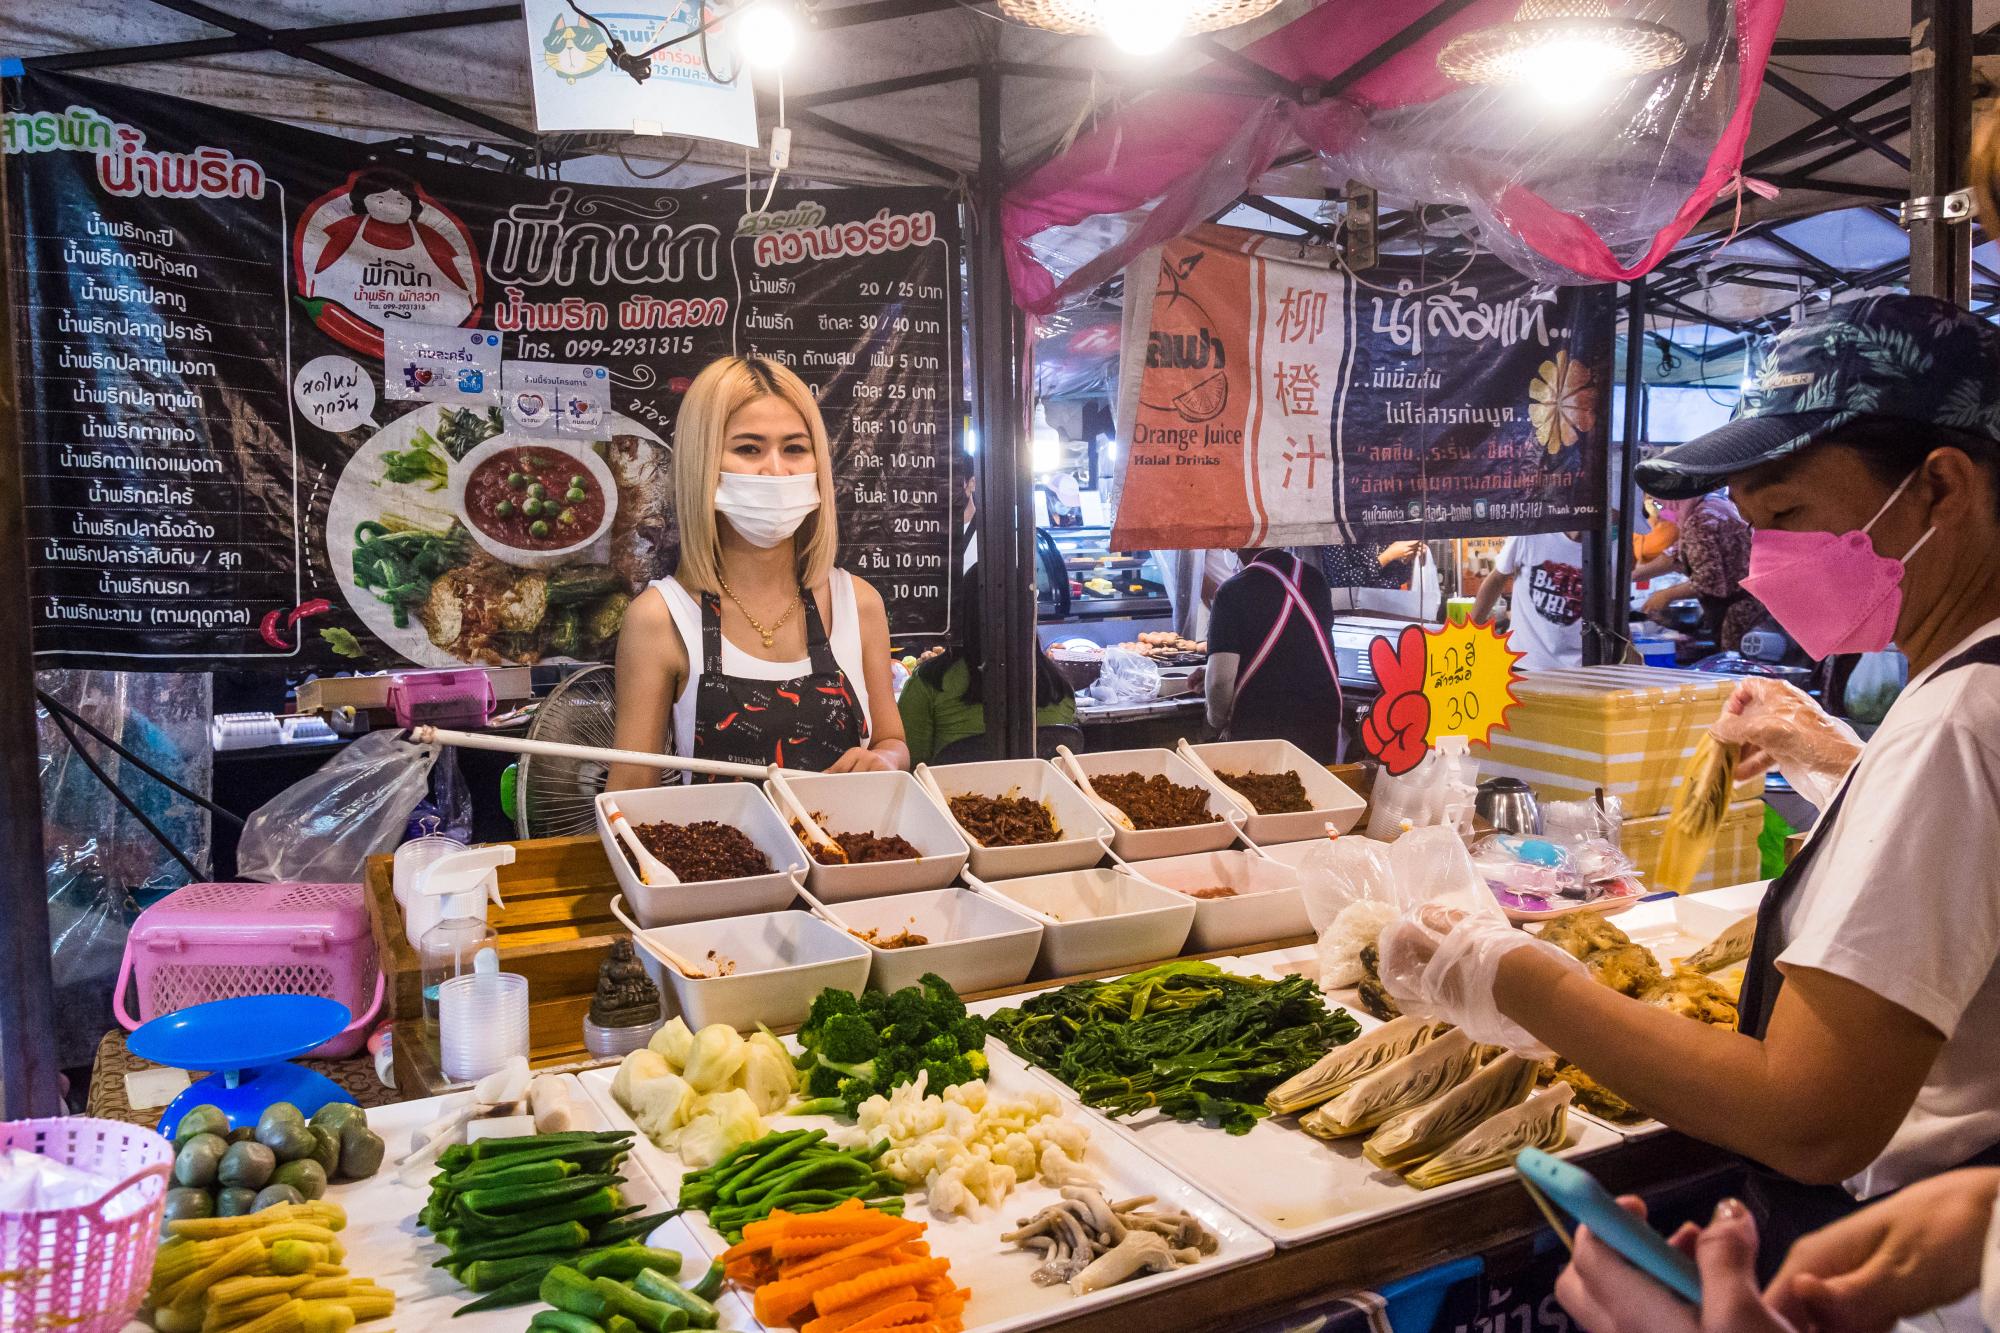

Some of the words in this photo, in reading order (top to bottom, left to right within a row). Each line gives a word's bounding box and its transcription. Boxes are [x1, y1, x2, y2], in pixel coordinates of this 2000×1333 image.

[100, 127, 262, 197] น้ำพริก
[87, 211, 173, 248] น้ำพริกกะปิ
[756, 207, 934, 266] ความอร่อย
[63, 239, 199, 279] น้ำพริกกะปิกุ้งสด
[81, 276, 188, 313] น้ำพริกปลาทู
[353, 285, 395, 303] น้ำพริก
[749, 272, 797, 295] น้ำพริก
[859, 282, 880, 296] 20
[885, 281, 894, 296] /
[898, 282, 914, 299] 25
[918, 284, 944, 300] บาท
[494, 286, 609, 333] น้ำพริก
[618, 294, 729, 332] ผักลวก
[745, 306, 794, 331] น้ำพริก
[817, 314, 854, 331] ขีดละ
[858, 314, 878, 330] 30
[881, 316, 889, 331] /
[892, 316, 910, 333] 40
[915, 319, 941, 335] บาท
[58, 344, 217, 378] น้ำพริกปลาทูแมงดา
[517, 334, 556, 360] โทร.
[564, 336, 695, 359] 099-2931315
[802, 349, 857, 367] ตักผสม
[870, 346, 895, 368] เพิ่ม
[899, 354, 909, 369] 5
[913, 356, 939, 370] บาท
[302, 365, 359, 397] สดใหม่
[852, 381, 883, 398] ตัวละ
[888, 384, 906, 399] 25
[912, 385, 936, 400] บาท
[1273, 286, 1329, 490] 柳橙汁
[73, 379, 203, 413] น้ำพริกปลาทูผัด
[312, 391, 359, 426] ทุกวัน
[629, 398, 672, 427] อร่อย
[852, 417, 884, 435] ขีดละ
[889, 419, 907, 434] 10
[912, 420, 937, 436] บาท
[82, 414, 196, 442] น้ำพริกตาแดง
[1132, 423, 1198, 451] Orange
[1203, 423, 1243, 448] Juice
[60, 444, 223, 474] น้ำพริกตาแดงแมงดา
[854, 450, 884, 468] กำละ
[890, 453, 907, 468] 10
[911, 454, 936, 469] บาท
[1133, 454, 1170, 467] Halal
[1175, 454, 1221, 467] Drinks
[88, 479, 196, 506] น้ำพริกตะไคร้
[854, 482, 887, 504] ชิ้นละ
[892, 489, 908, 504] 10
[912, 490, 938, 504] บาท
[1547, 504, 1571, 515] Thank
[1573, 505, 1599, 517] you.
[72, 511, 216, 539] น้ำพริกปลาฉิ้งฉ้าง
[894, 518, 910, 533] 20
[914, 519, 940, 533] บาท
[45, 537, 195, 566] น้ำพริกปลาร้าสับดิบ
[201, 550, 212, 566] /
[218, 551, 243, 571] สุก
[858, 554, 867, 569] 4
[872, 547, 890, 569] ชิ้น
[896, 554, 912, 569] 10
[916, 554, 941, 568] บาท
[99, 571, 191, 596] น้ำพริกนรก
[893, 584, 909, 599] 10
[913, 585, 939, 599] บาท
[45, 597, 142, 623] น้ำพริกมะขาม
[150, 607, 251, 629] (ตามฤดูกาล)
[1446, 690, 1480, 731] 30
